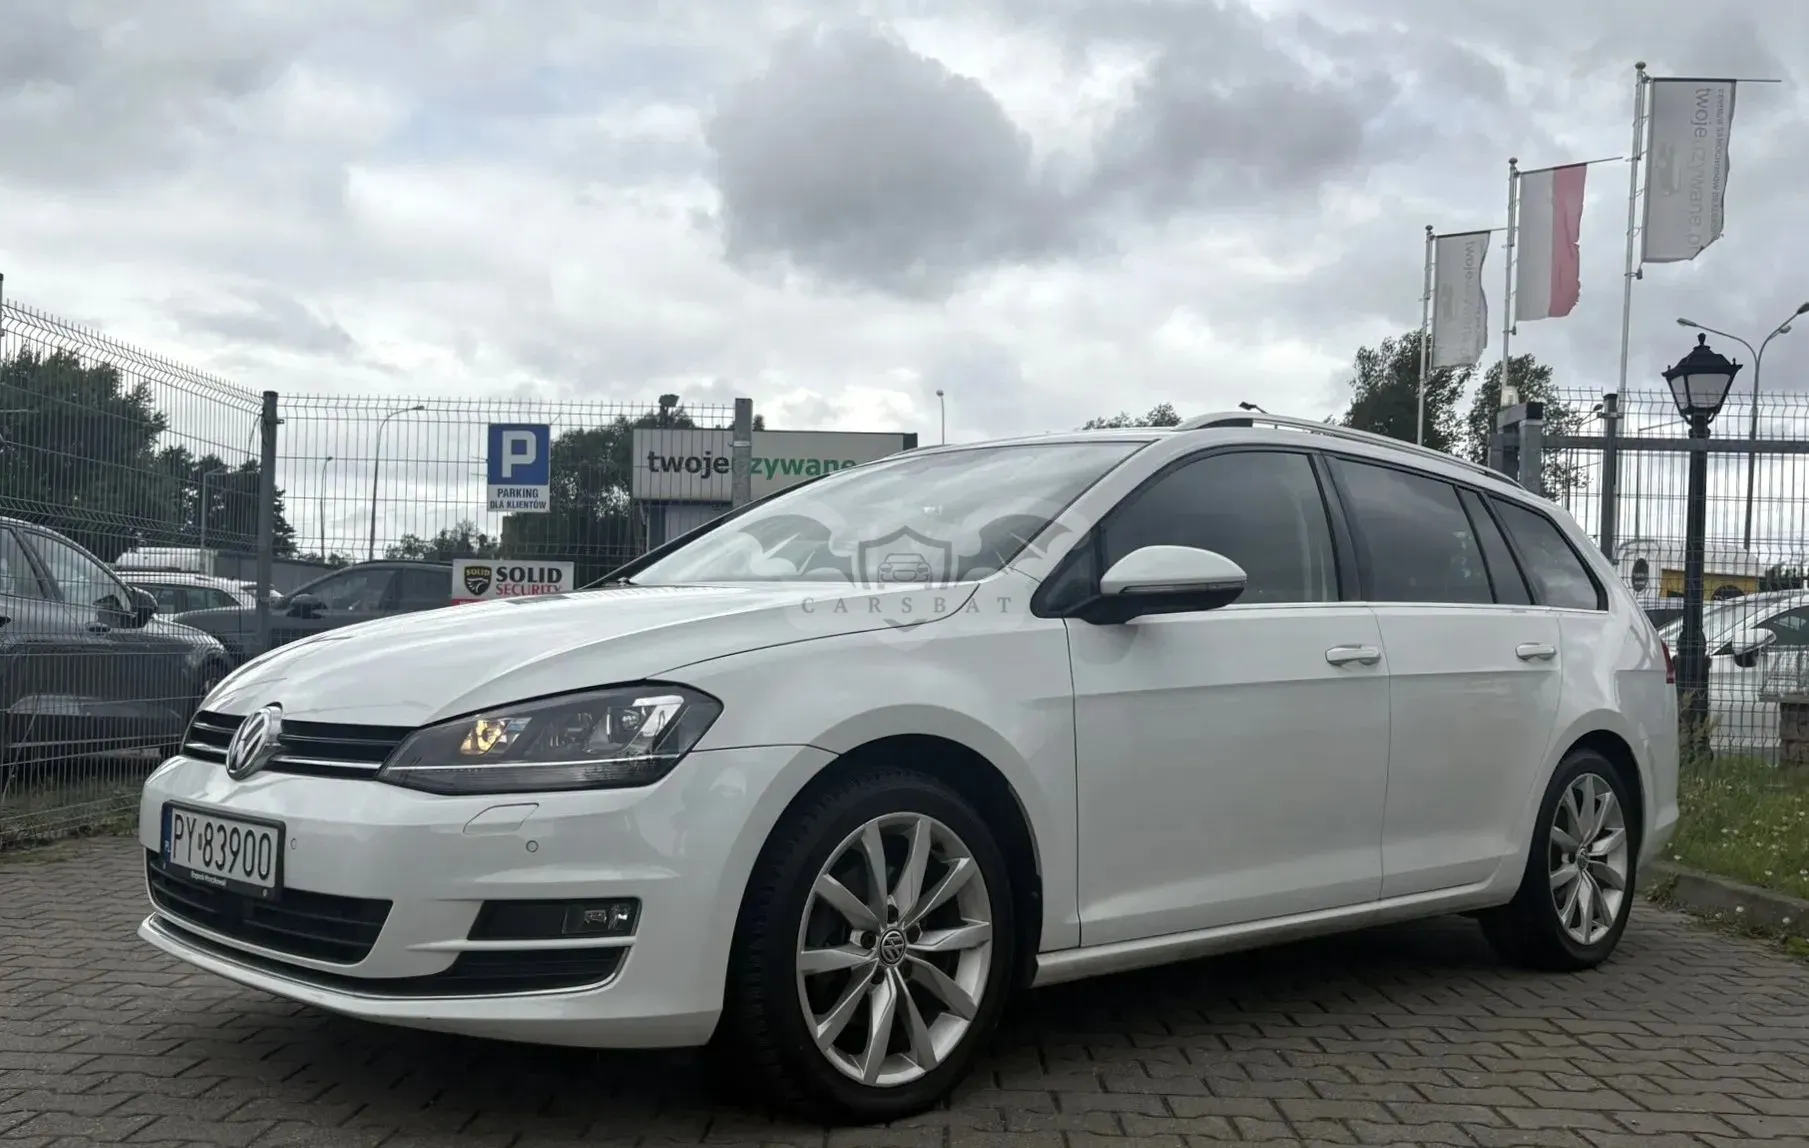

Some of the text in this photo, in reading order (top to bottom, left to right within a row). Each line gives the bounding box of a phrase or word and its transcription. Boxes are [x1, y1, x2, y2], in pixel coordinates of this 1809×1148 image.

[502, 430, 537, 478] P
[497, 488, 539, 498] PARKING
[490, 499, 547, 509] DLA KLIENTÓW
[466, 568, 490, 576] SOLID
[496, 566, 562, 583] SOLID
[496, 584, 561, 595] SECURITY
[174, 814, 271, 880] PY 83900
